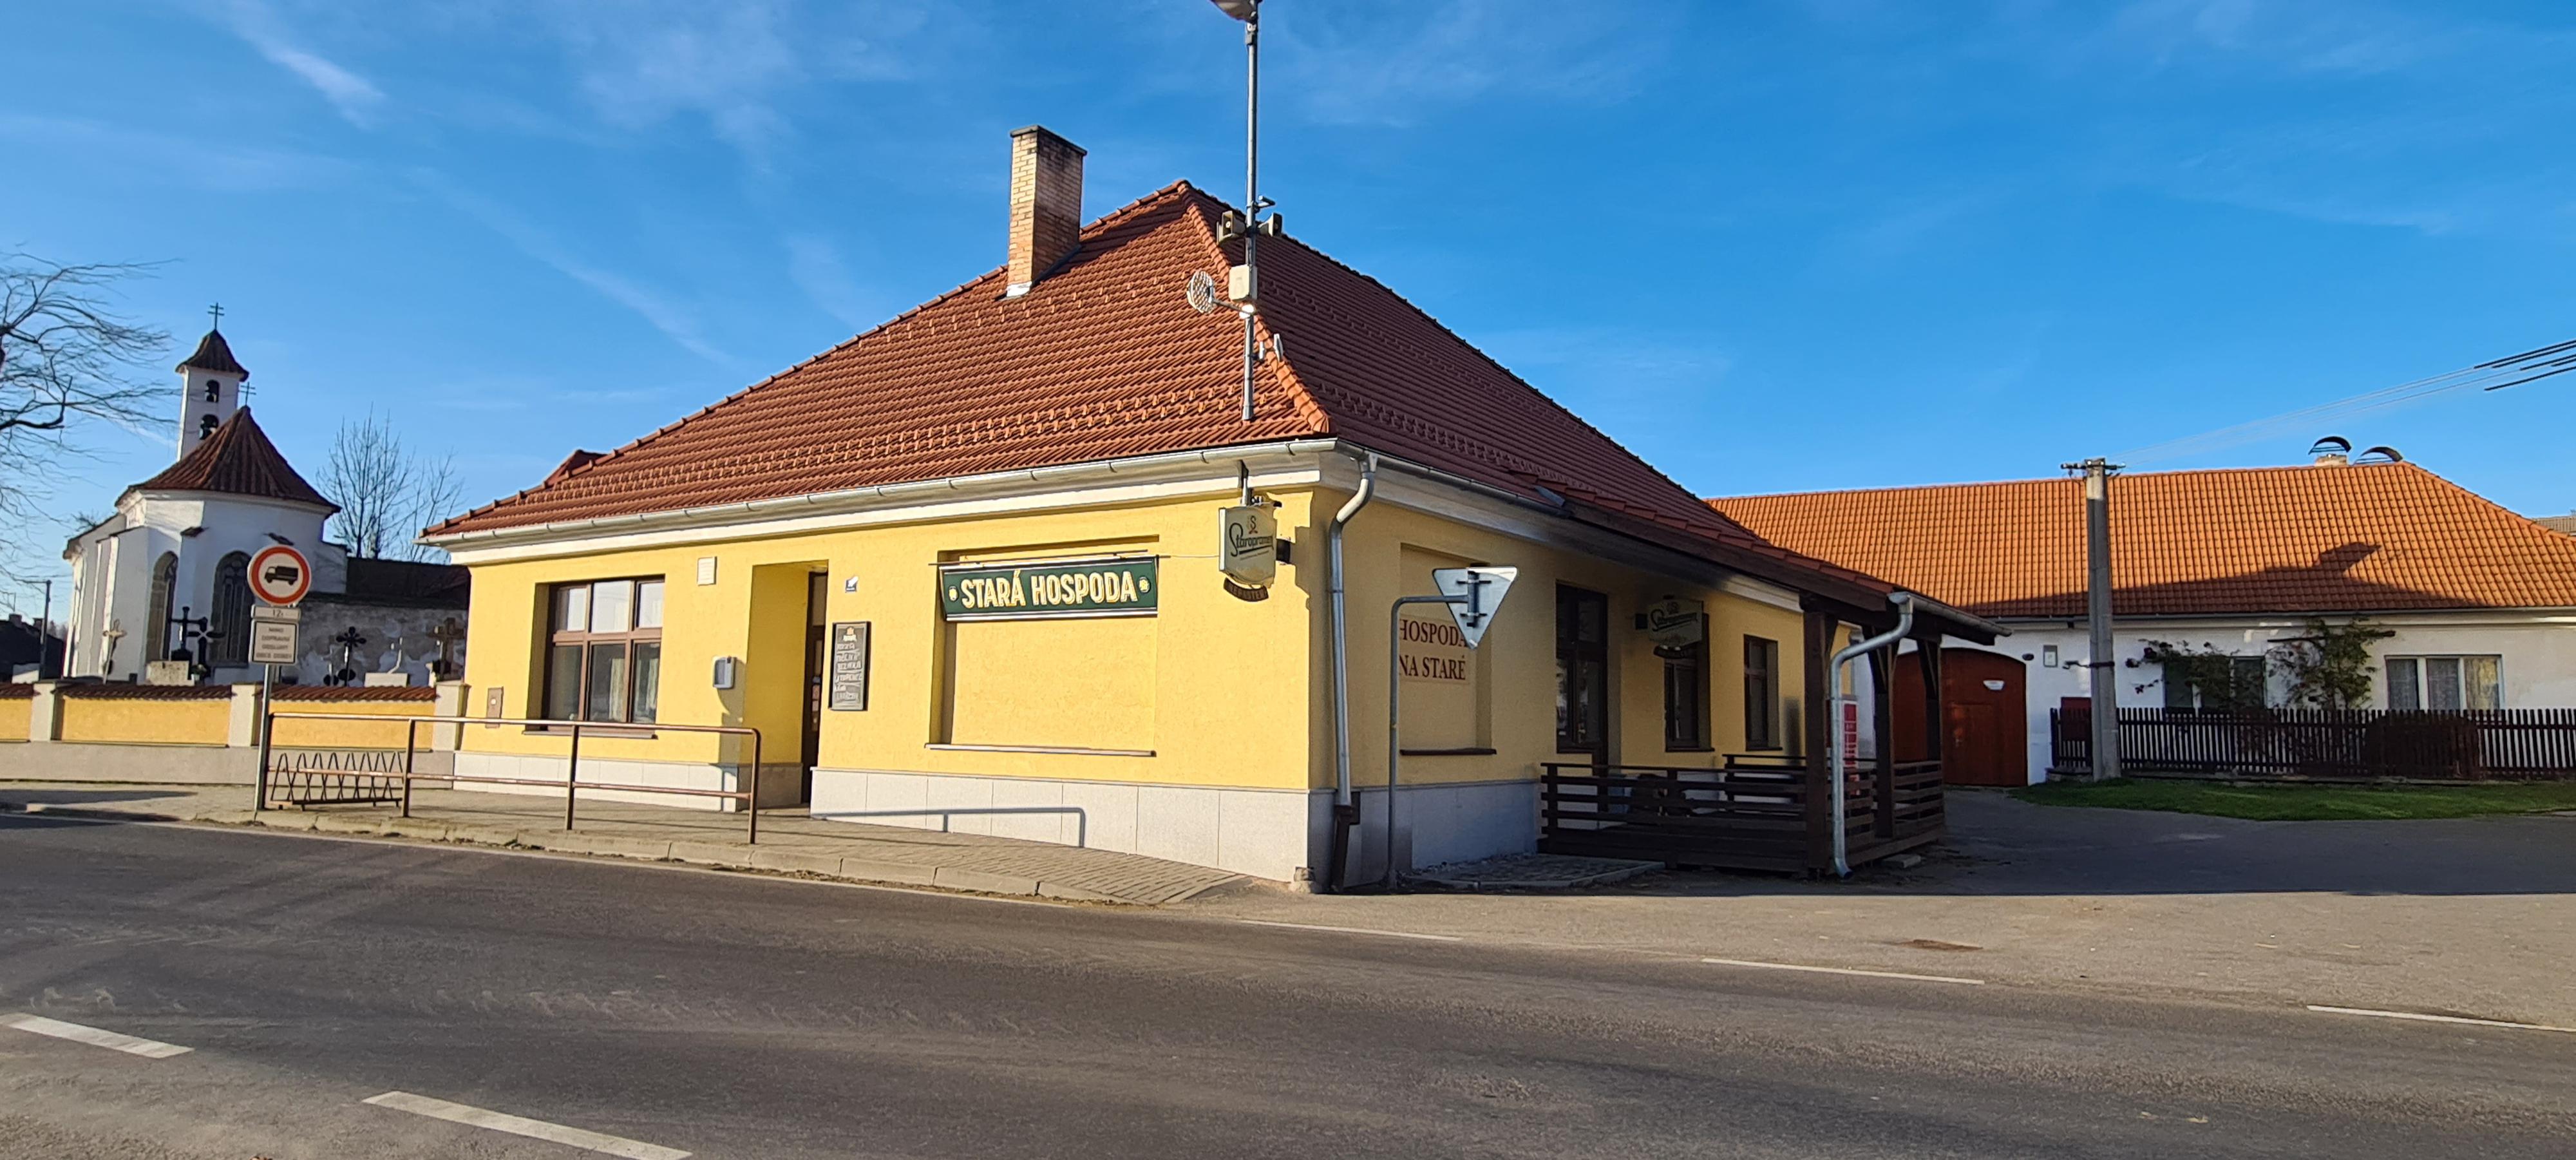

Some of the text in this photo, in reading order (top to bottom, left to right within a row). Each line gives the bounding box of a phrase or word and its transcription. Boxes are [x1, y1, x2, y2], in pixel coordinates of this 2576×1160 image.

[1229, 522, 1274, 556] Staropramen
[960, 569, 1139, 609] STARÁ HOSPODA
[1422, 654, 1466, 681] STARÉ
